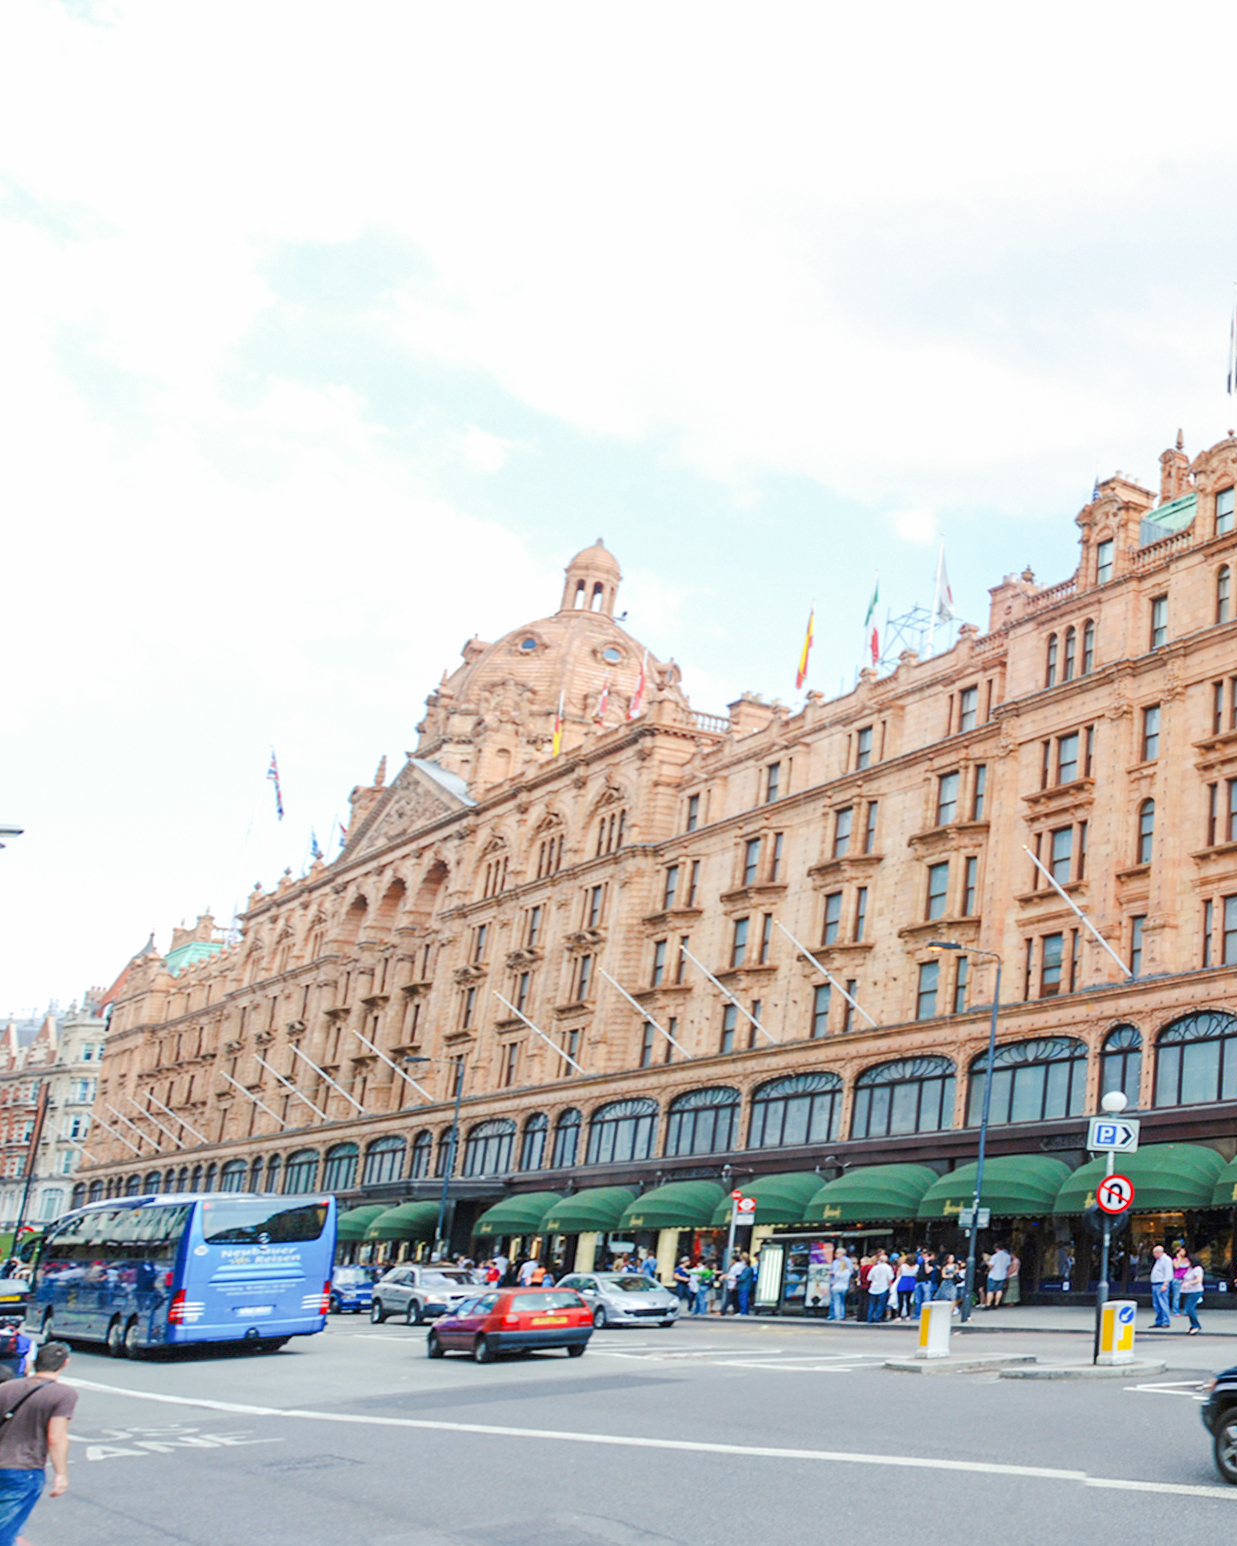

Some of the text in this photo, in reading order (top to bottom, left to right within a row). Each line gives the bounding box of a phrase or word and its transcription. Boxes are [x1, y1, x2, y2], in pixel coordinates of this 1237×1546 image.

[1099, 1126, 1114, 1142] P
[66, 1424, 200, 1443] US
[66, 1430, 285, 1464] ANE
